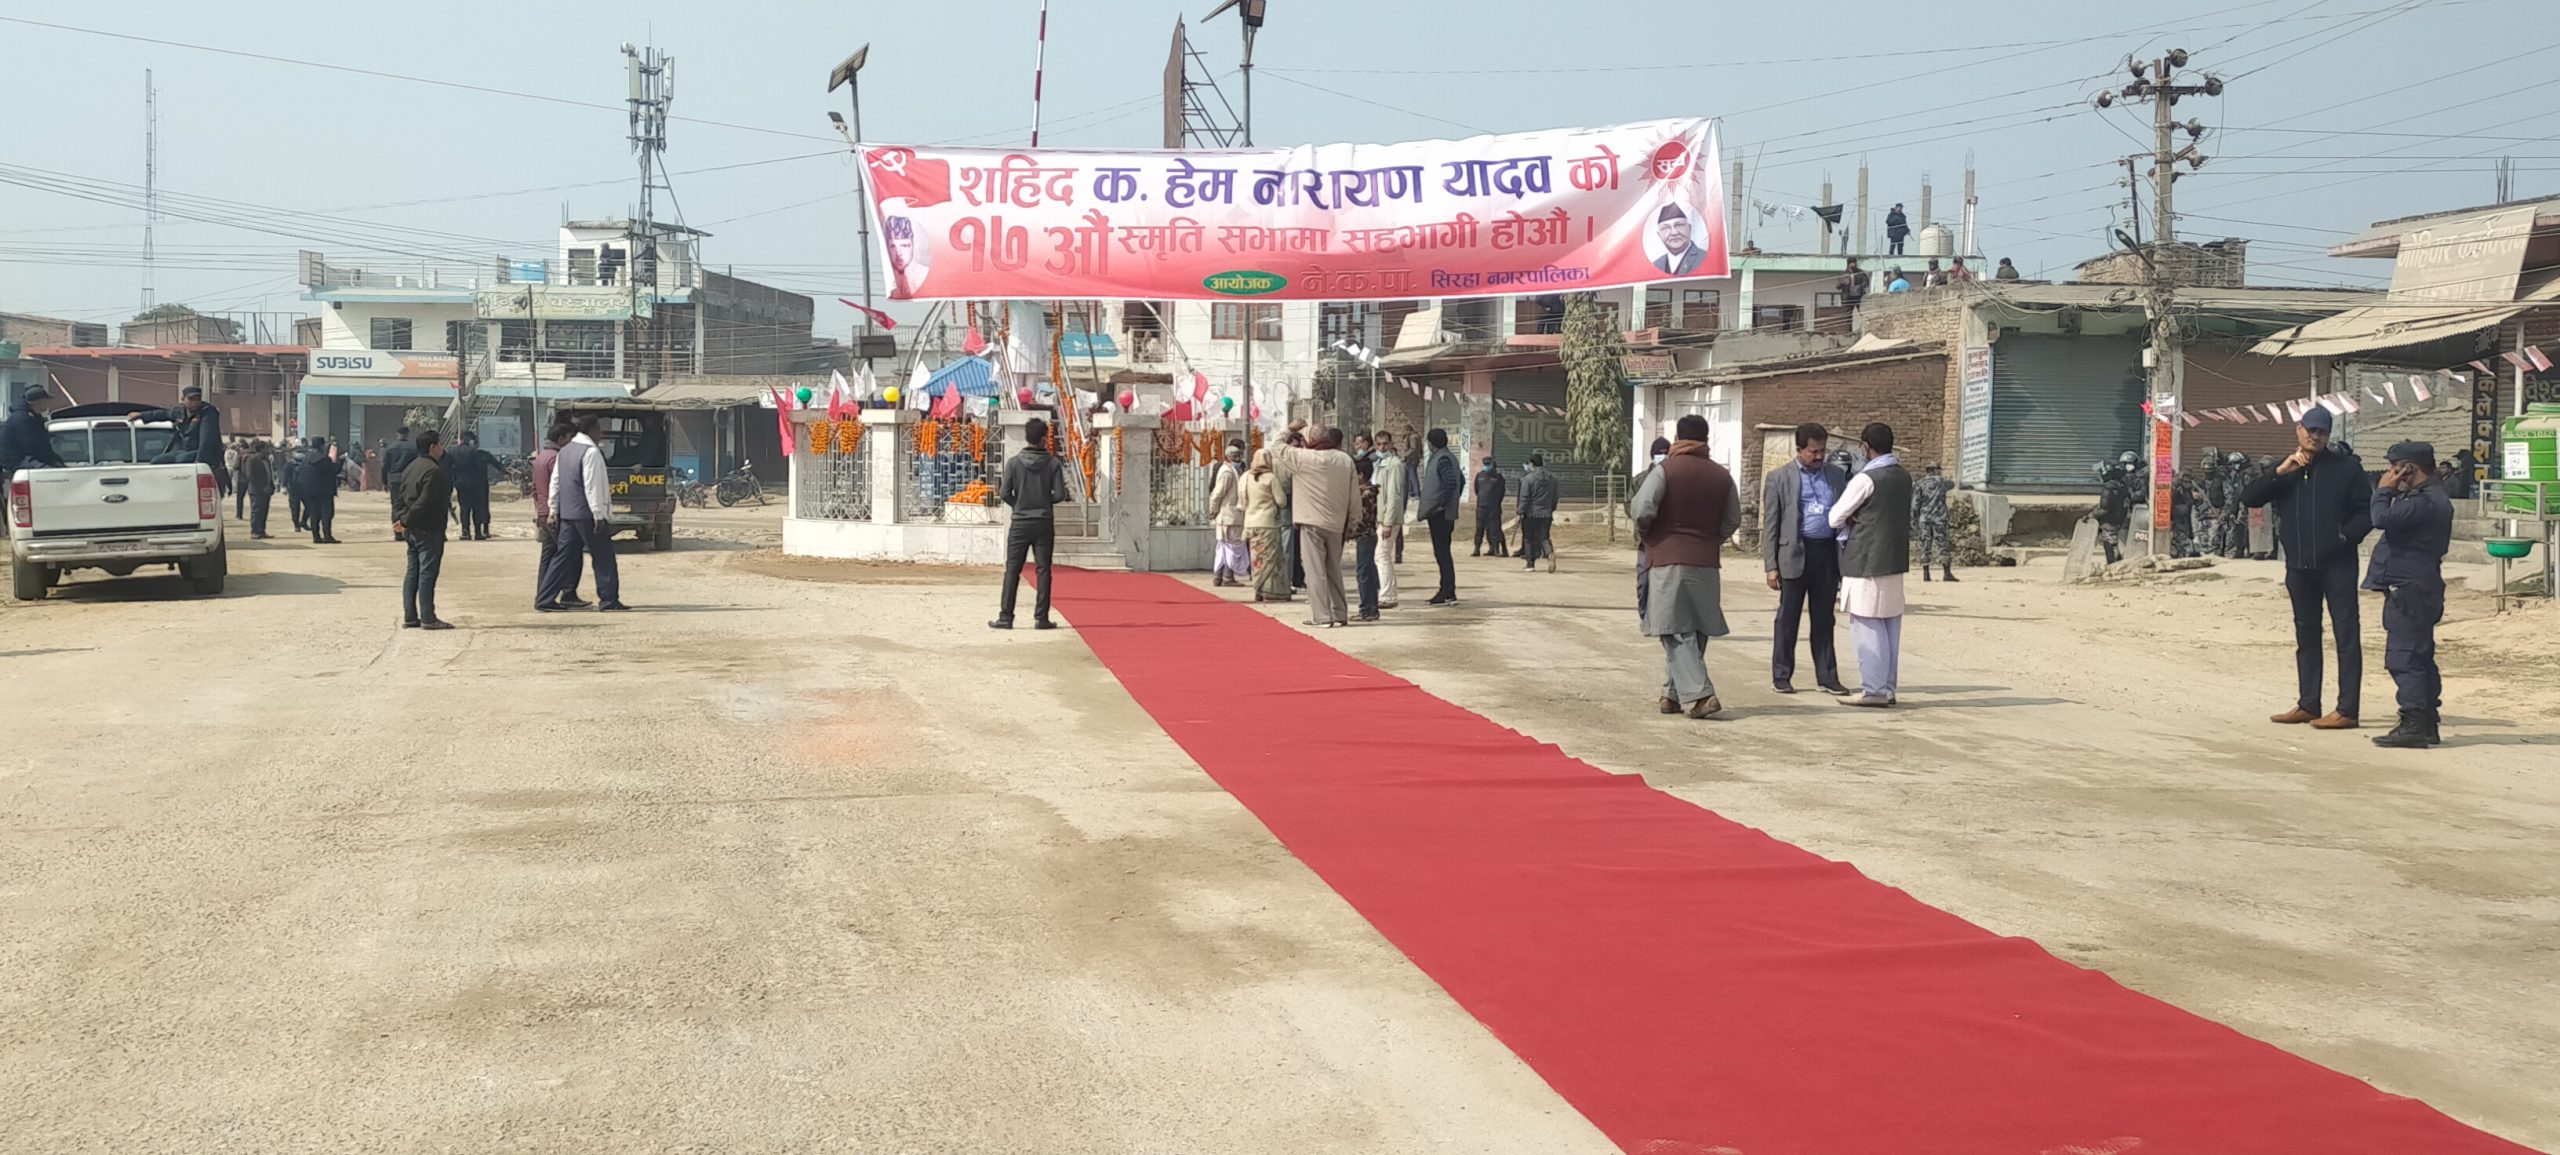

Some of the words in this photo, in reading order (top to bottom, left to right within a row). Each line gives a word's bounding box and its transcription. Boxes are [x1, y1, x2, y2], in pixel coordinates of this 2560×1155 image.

[959, 154, 1078, 208] शहिद
[1093, 167, 1147, 203] क.
[1165, 158, 1237, 208] हेम
[1253, 165, 1424, 209] नारायण
[1442, 156, 1552, 199] यादव
[1567, 144, 1620, 191] को
[949, 216, 1029, 272] १७
[1118, 217, 1205, 260] स्मृति
[1218, 225, 1330, 254] सभामा
[1342, 212, 1480, 254] सहभागी
[1210, 275, 1272, 290] आयोजक
[1431, 270, 1480, 289] सिरहा
[1488, 265, 1590, 286] नगरपालिका
[629, 474, 665, 485] POLICE
